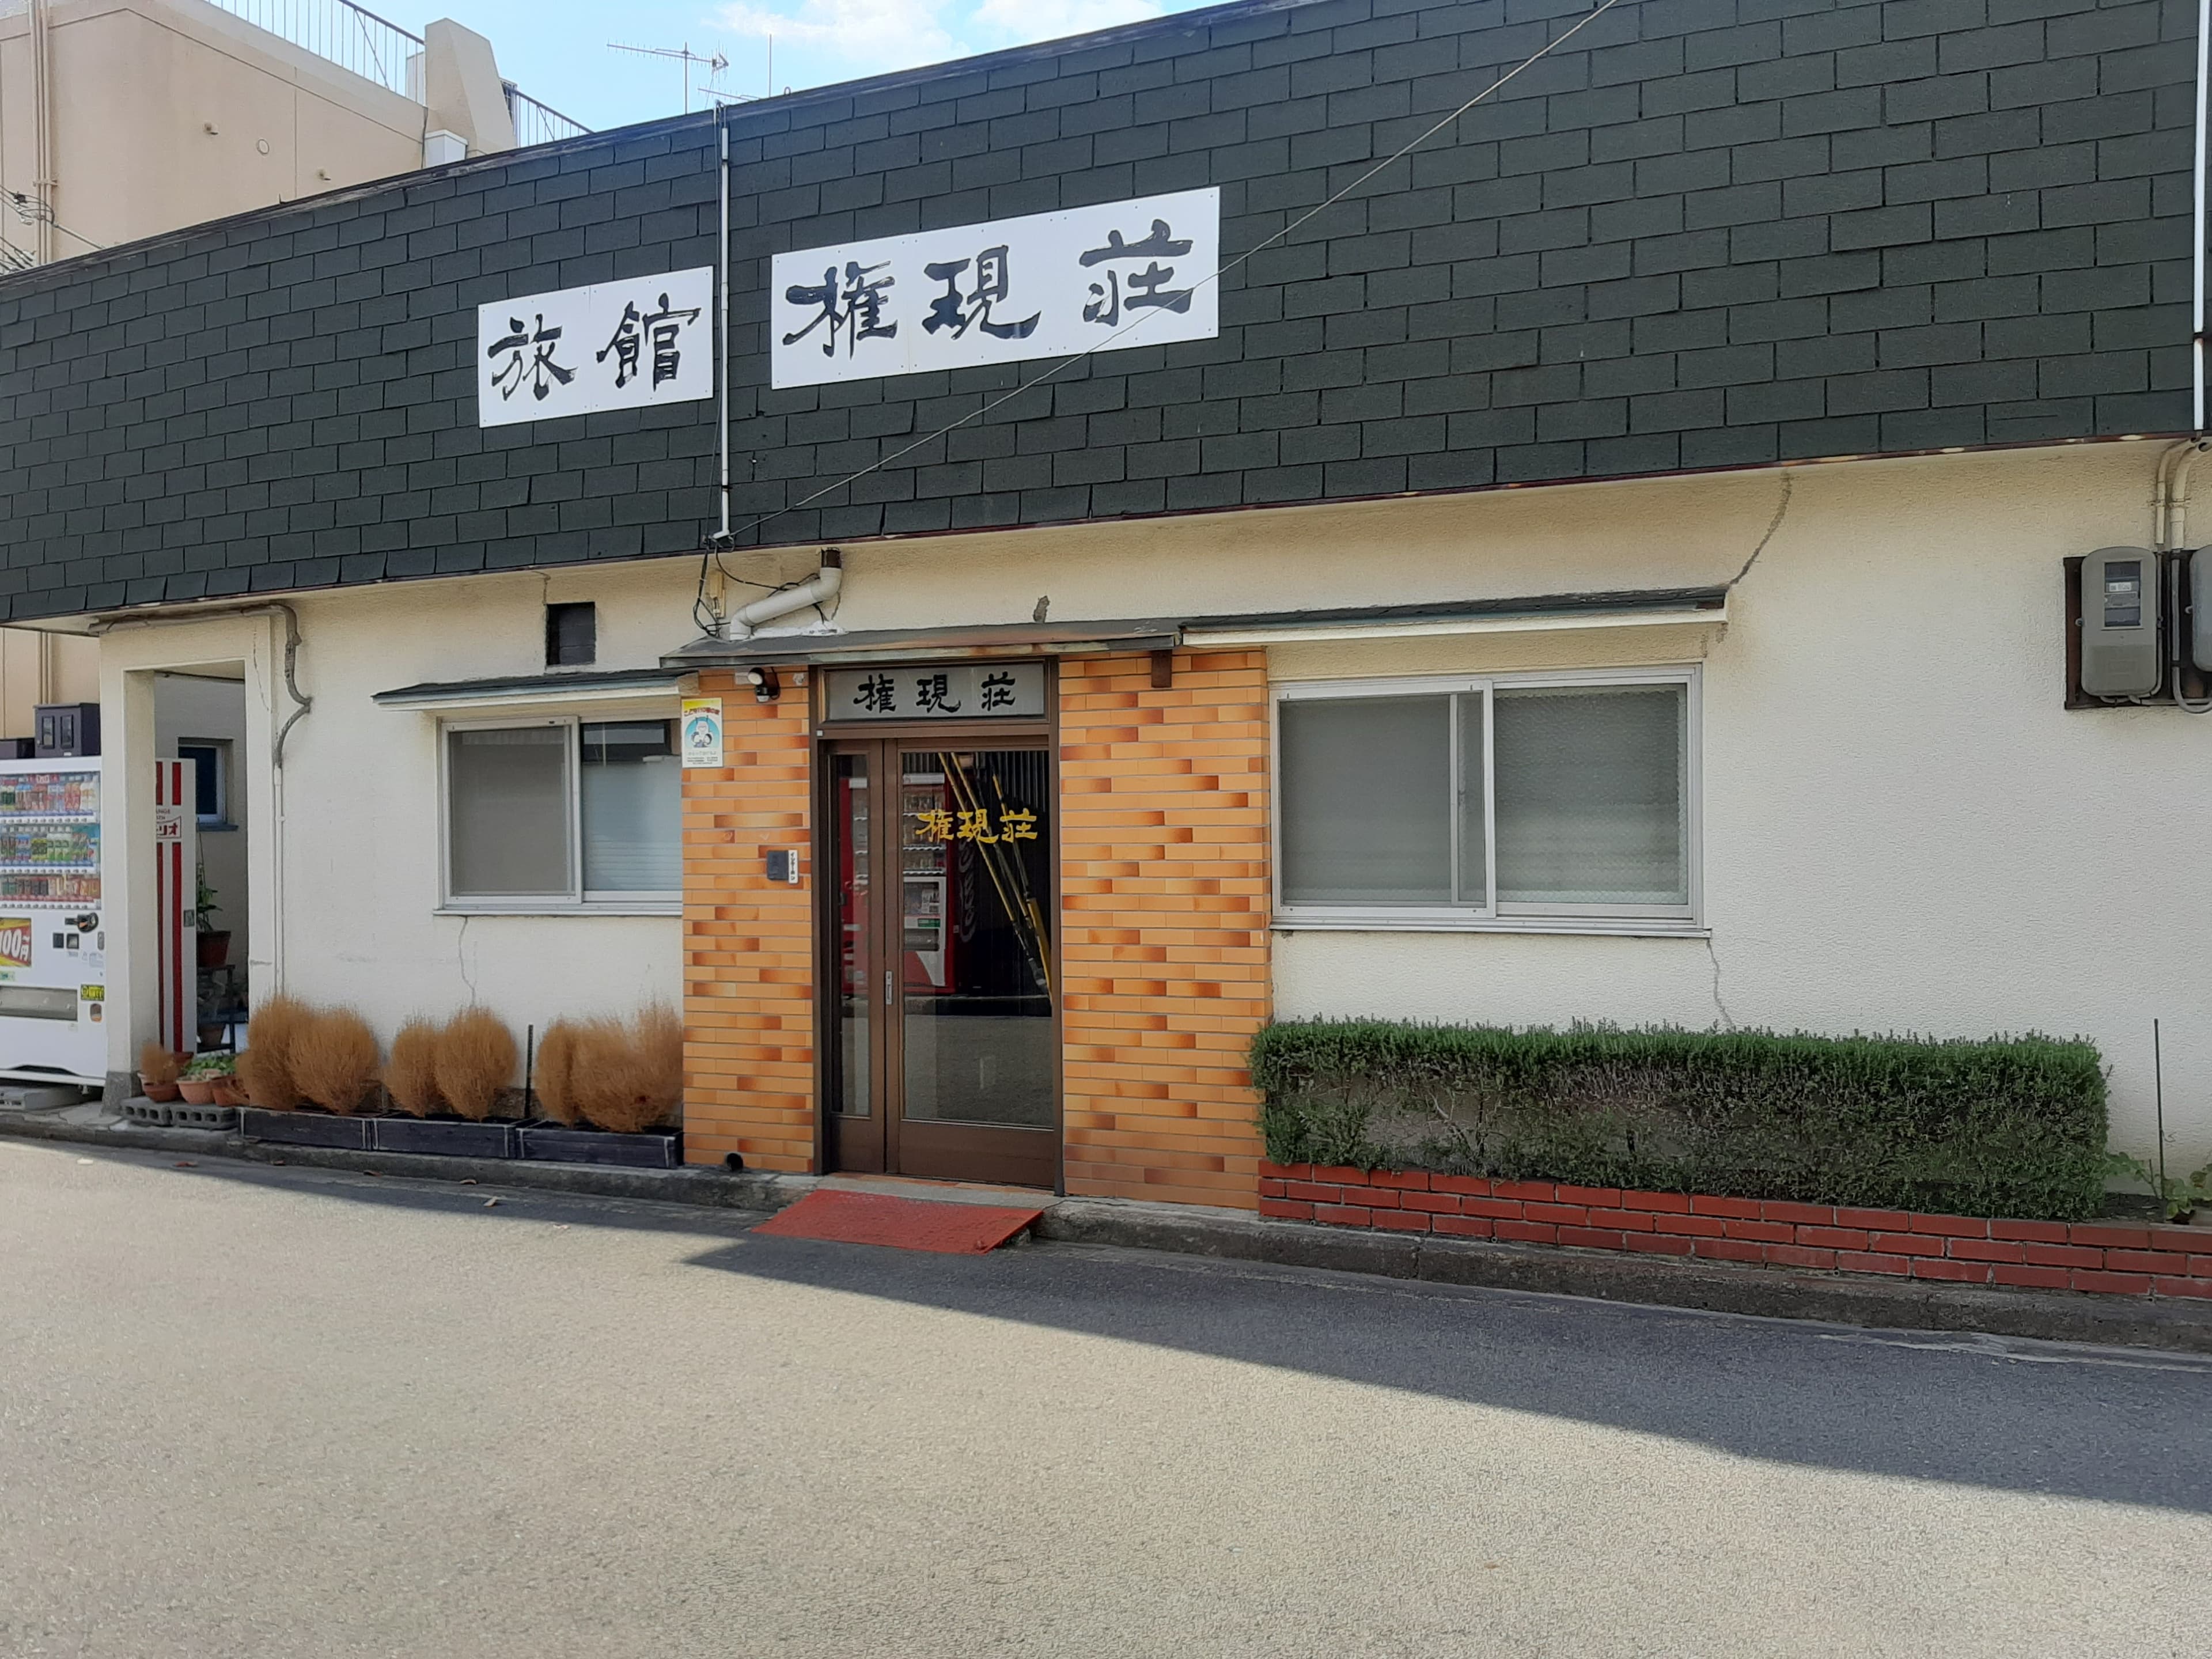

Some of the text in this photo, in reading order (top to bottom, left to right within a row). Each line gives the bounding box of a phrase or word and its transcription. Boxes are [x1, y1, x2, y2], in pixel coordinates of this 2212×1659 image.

[783, 218, 1195, 358] 権現荘
[488, 292, 702, 402] 旅館
[853, 671, 1016, 713] 権現荘
[915, 808, 1038, 843] 権現荘
